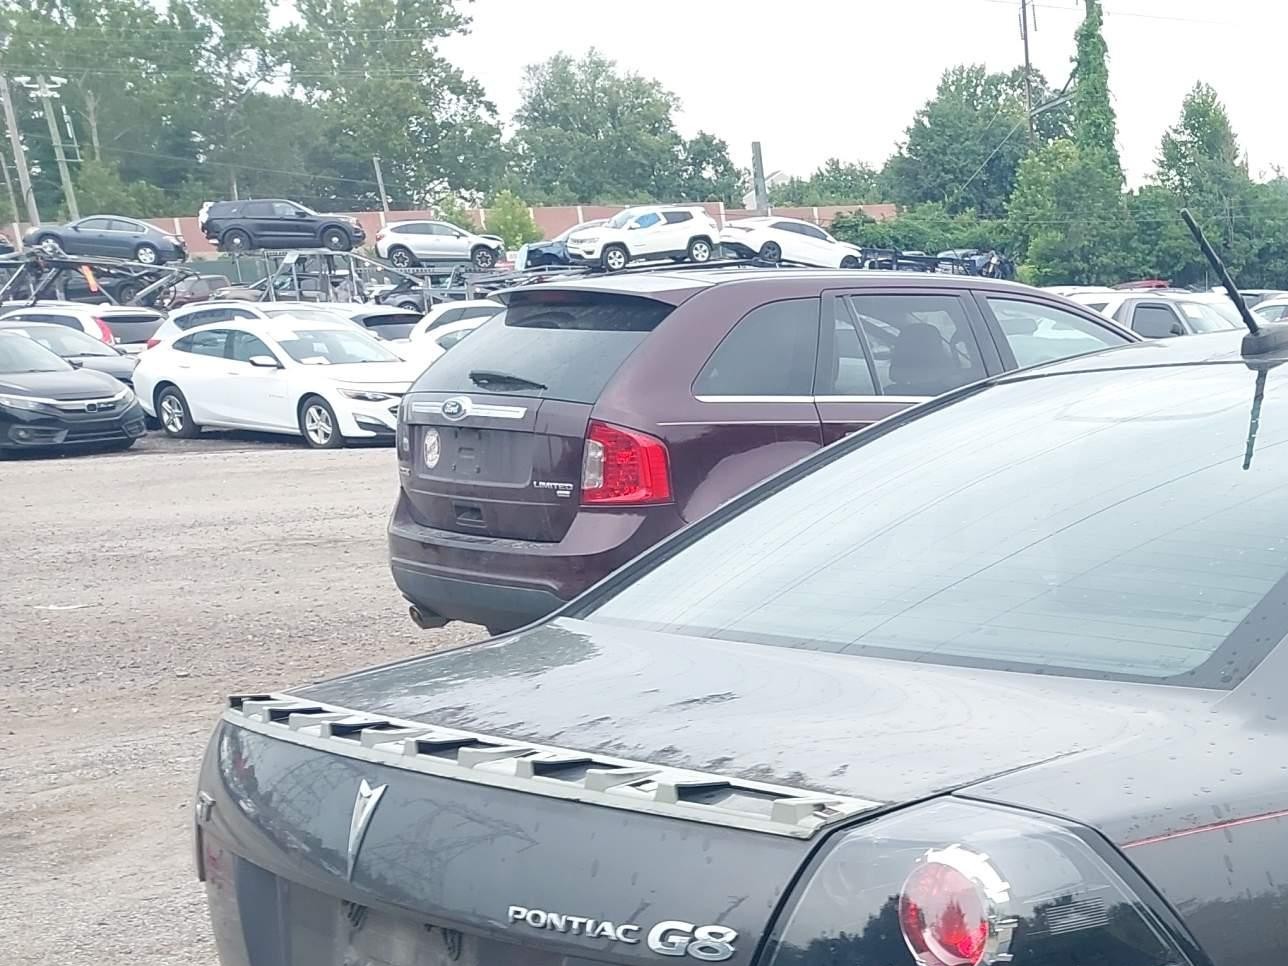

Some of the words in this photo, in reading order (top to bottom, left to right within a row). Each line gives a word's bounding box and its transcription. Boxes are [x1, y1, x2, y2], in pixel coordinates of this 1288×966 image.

[532, 480, 574, 491] LIMITED
[507, 905, 641, 944] PONTIAC
[647, 919, 739, 962] G8
